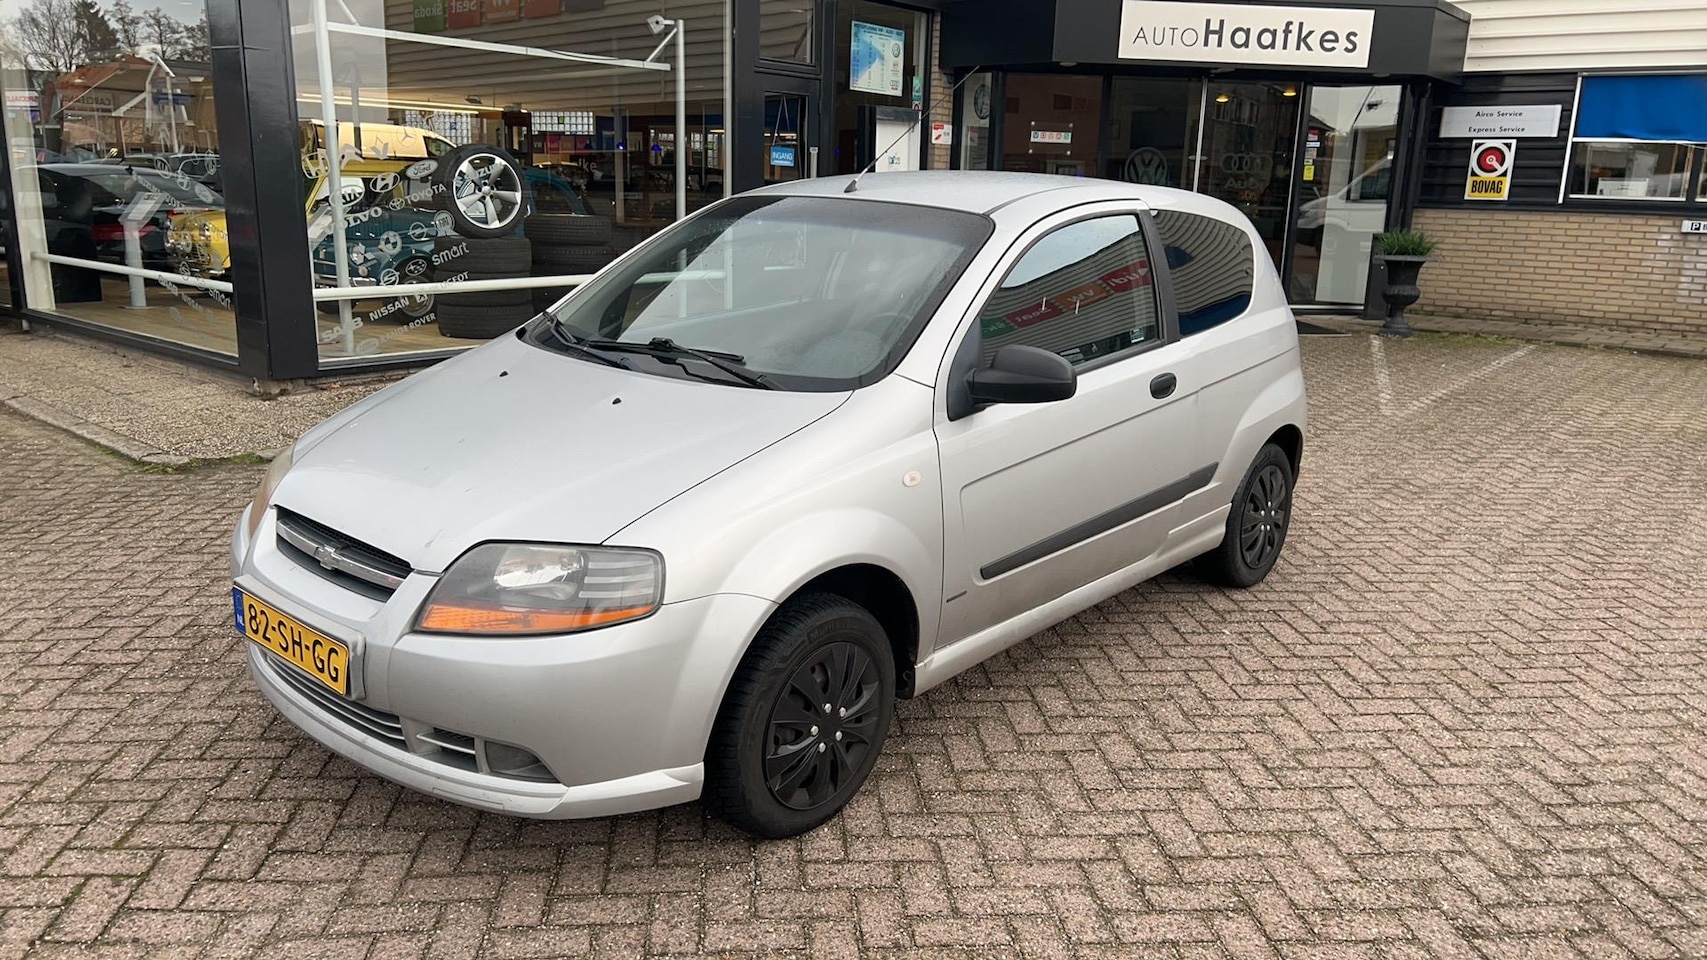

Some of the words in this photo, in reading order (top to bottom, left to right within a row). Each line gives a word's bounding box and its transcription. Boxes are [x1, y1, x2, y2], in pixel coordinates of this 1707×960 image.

[1475, 110, 1494, 118] Airco
[1468, 126, 1497, 134] Express
[772, 151, 793, 161] INGANG
[405, 183, 447, 205] TOYOTA
[1471, 179, 1503, 194] BOVAG
[432, 241, 469, 265] smart
[369, 296, 410, 321] NISSAN
[409, 312, 436, 329] ROVER
[236, 613, 245, 626] NL
[248, 602, 339, 683] 82-SH-GG
